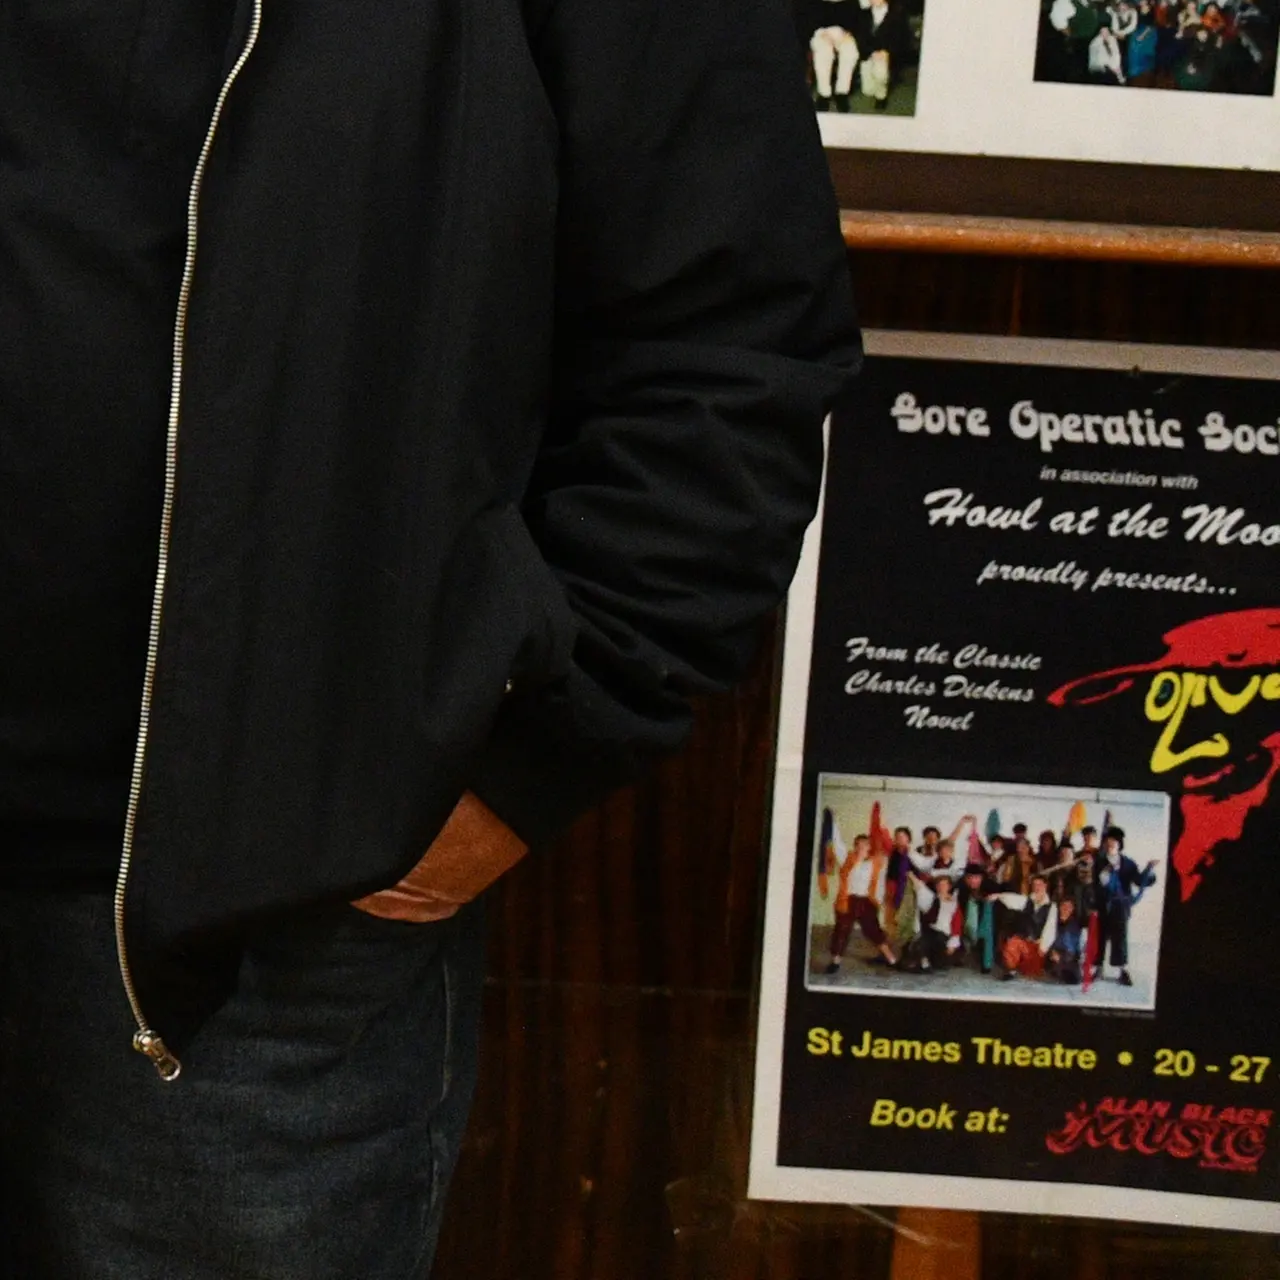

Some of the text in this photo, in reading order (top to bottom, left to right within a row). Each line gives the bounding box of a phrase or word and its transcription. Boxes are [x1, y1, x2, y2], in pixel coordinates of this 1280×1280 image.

[1009, 400, 1184, 452] Operatic
[1040, 465, 1198, 489] in association with
[923, 487, 1043, 531] Howl
[1050, 506, 1099, 534] at
[1107, 503, 1169, 539] the
[976, 560, 1088, 591] proudly
[845, 636, 1042, 670] From the Classic
[845, 669, 1035, 702] Charles Dickens
[904, 704, 974, 730] Novel
[807, 1027, 843, 1055] St
[851, 1031, 961, 1063] James
[971, 1036, 1096, 1069] Theatre
[1153, 1048, 1196, 1076] 20
[1229, 1055, 1271, 1083] 27
[870, 1098, 1010, 1133] Book at:
